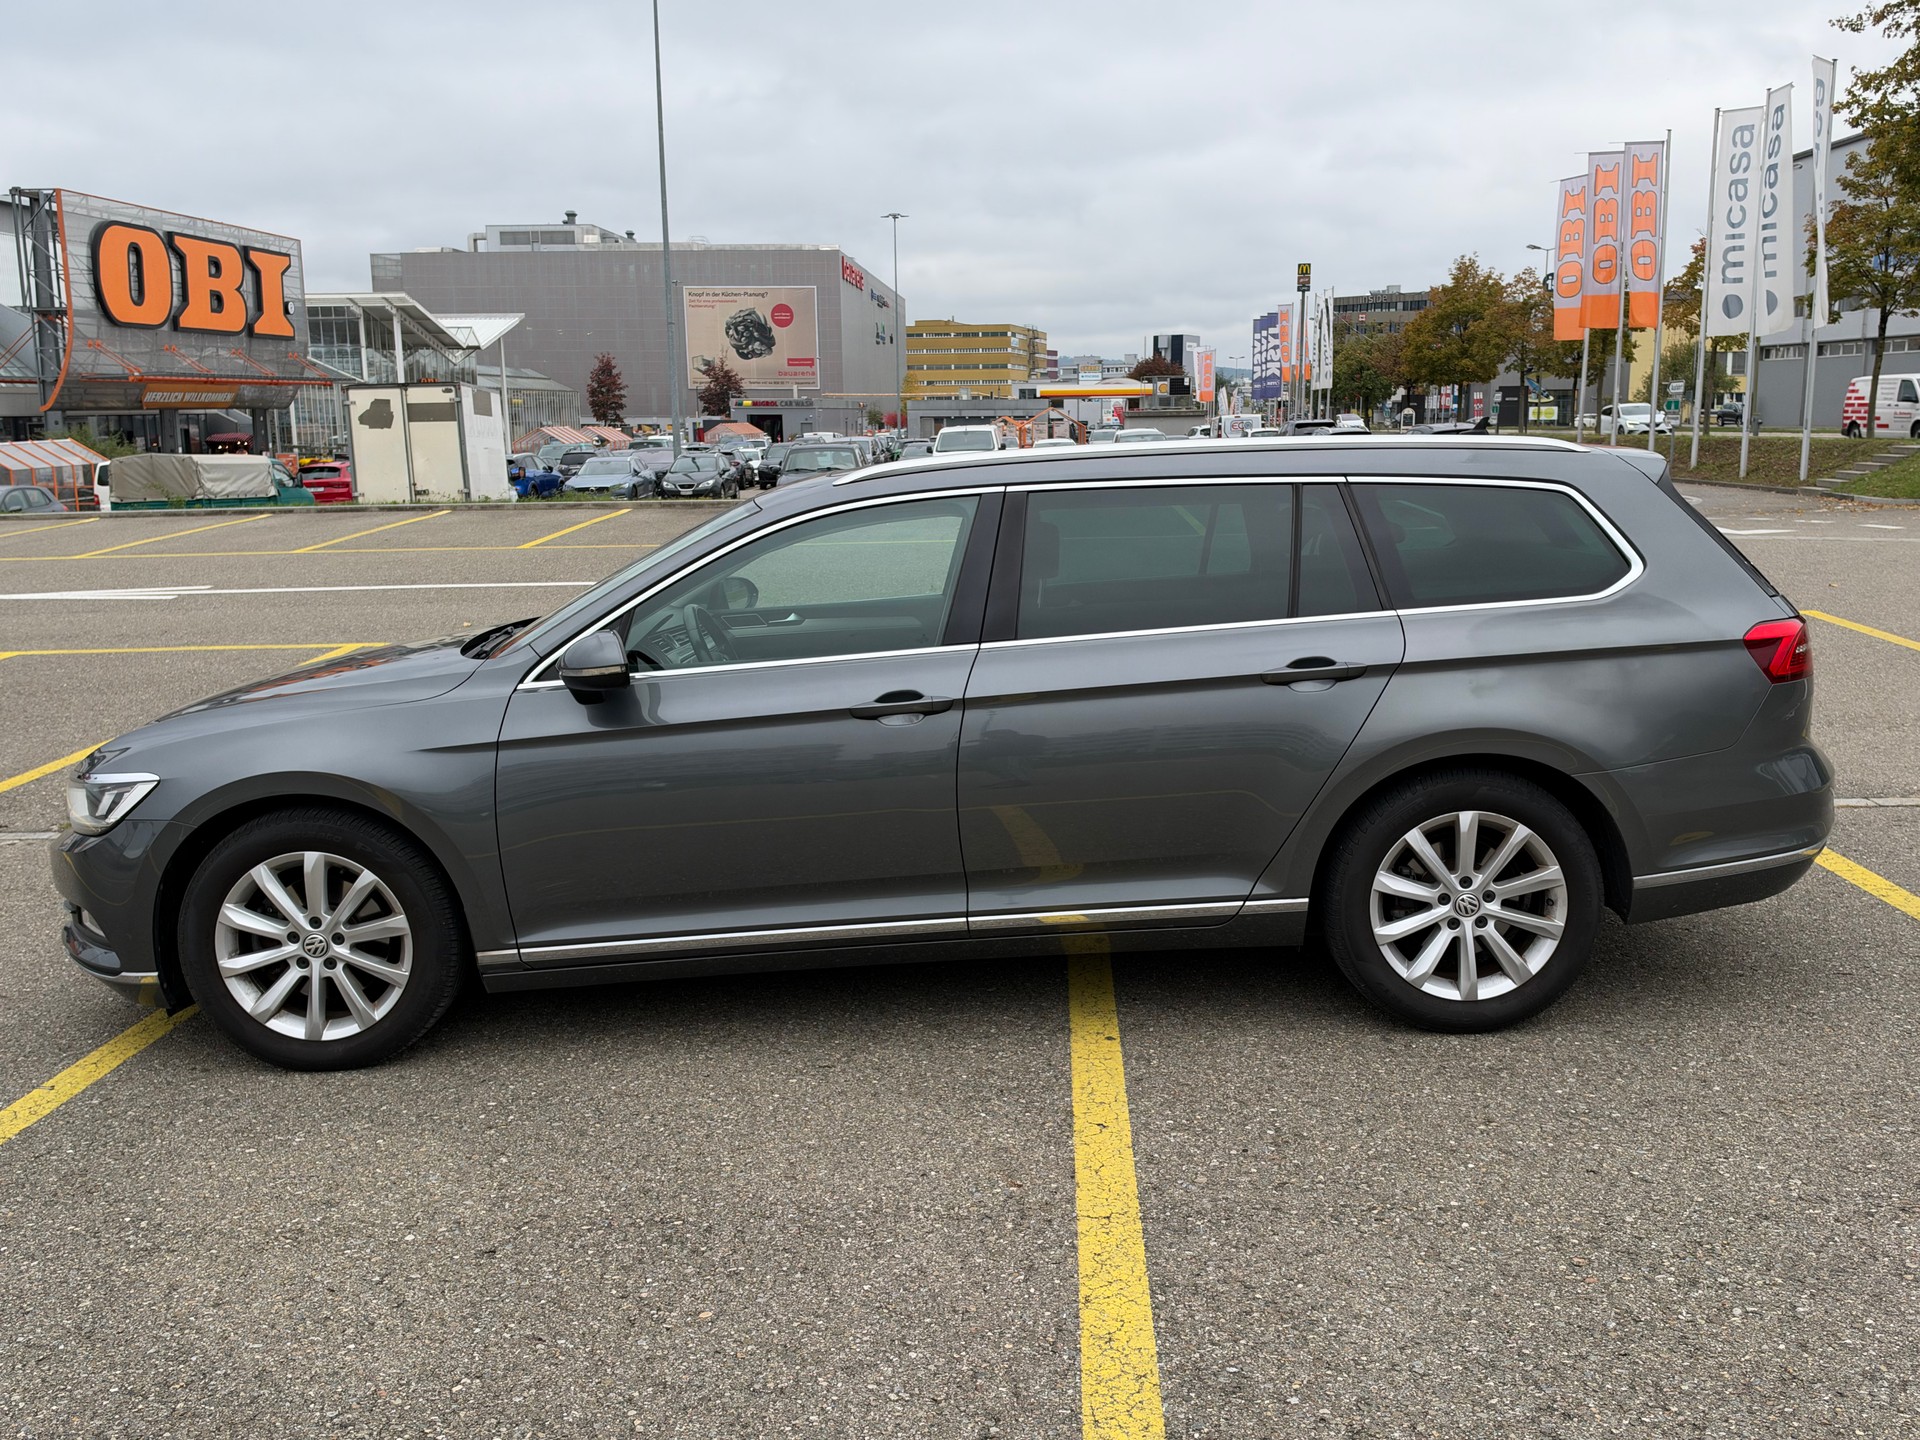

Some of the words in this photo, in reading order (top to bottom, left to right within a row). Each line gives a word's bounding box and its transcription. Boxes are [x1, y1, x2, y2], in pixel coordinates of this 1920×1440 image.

[1556, 185, 1586, 298] OBI
[1592, 162, 1620, 285] OBI
[1631, 152, 1658, 281] OBI
[1722, 123, 1755, 284] micasa
[1761, 103, 1785, 279] micasa
[91, 220, 295, 341] OBI
[144, 391, 184, 402] HERZLICH
